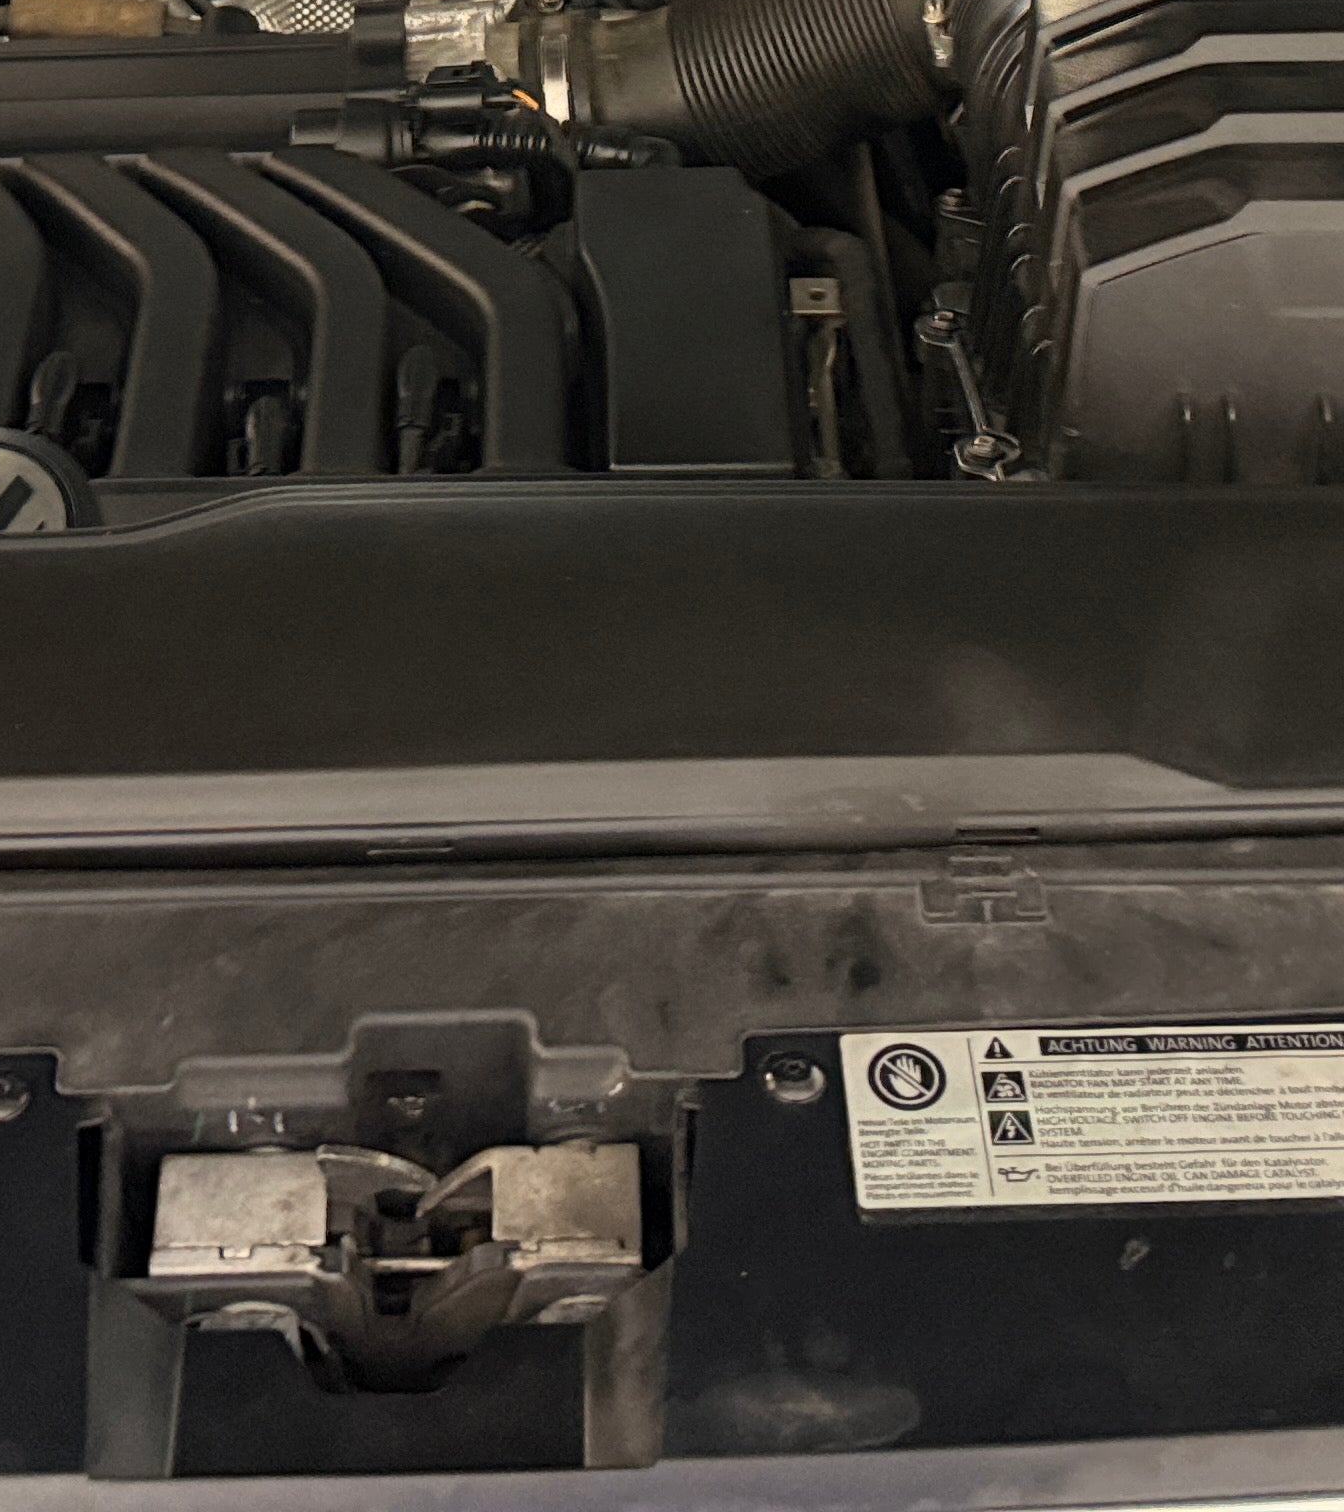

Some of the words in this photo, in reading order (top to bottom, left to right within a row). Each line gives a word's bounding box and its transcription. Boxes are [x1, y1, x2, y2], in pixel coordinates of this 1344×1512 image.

[1045, 1038, 1138, 1053] ACHTUNG
[1146, 1036, 1237, 1051] WARNING
[1029, 1079, 1084, 1088] RADIATOR
[1086, 1078, 1108, 1087] FAN
[1111, 1078, 1137, 1086] MAY
[1139, 1077, 1172, 1086] START
[1172, 1077, 1187, 1085] AT
[1189, 1076, 1211, 1085] ANY
[1031, 1091, 1044, 1099] Le
[1045, 1090, 1104, 1099] ventilateur
[1106, 1089, 1121, 1098] de
[1174, 1088, 1200, 1098] peut
[1287, 1085, 1313, 1094] tout
[1192, 1103, 1210, 1111] der
[1277, 1100, 1313, 1109] Motor
[1036, 1116, 1066, 1125] HIGH
[1121, 1114, 1166, 1123] SWITCH
[1168, 1113, 1189, 1122] OFF
[1191, 1112, 1234, 1122] ENGINE
[1235, 1111, 1278, 1121] BEFORE
[1279, 1110, 1340, 1120] TOUCHING
[860, 1140, 881, 1148] HOT
[883, 1139, 912, 1147] PARTS
[1040, 1139, 1076, 1148] Haute
[1175, 1135, 1217, 1145] moteur
[1218, 1134, 1250, 1144] avant
[1251, 1134, 1267, 1143] de
[861, 1149, 898, 1157] ENGINE
[862, 1159, 905, 1168] MOVING
[1044, 1162, 1062, 1172] Bei
[1177, 1159, 1216, 1169] Gefahr
[1221, 1159, 1237, 1168] für
[1239, 1157, 1261, 1167] den
[1047, 1173, 1112, 1183] OVERFILLED
[1114, 1172, 1157, 1181] ENGINE
[1159, 1171, 1180, 1180] OIL
[1182, 1171, 1208, 1180] CAN
[1210, 1169, 1260, 1179] DAMAGE
